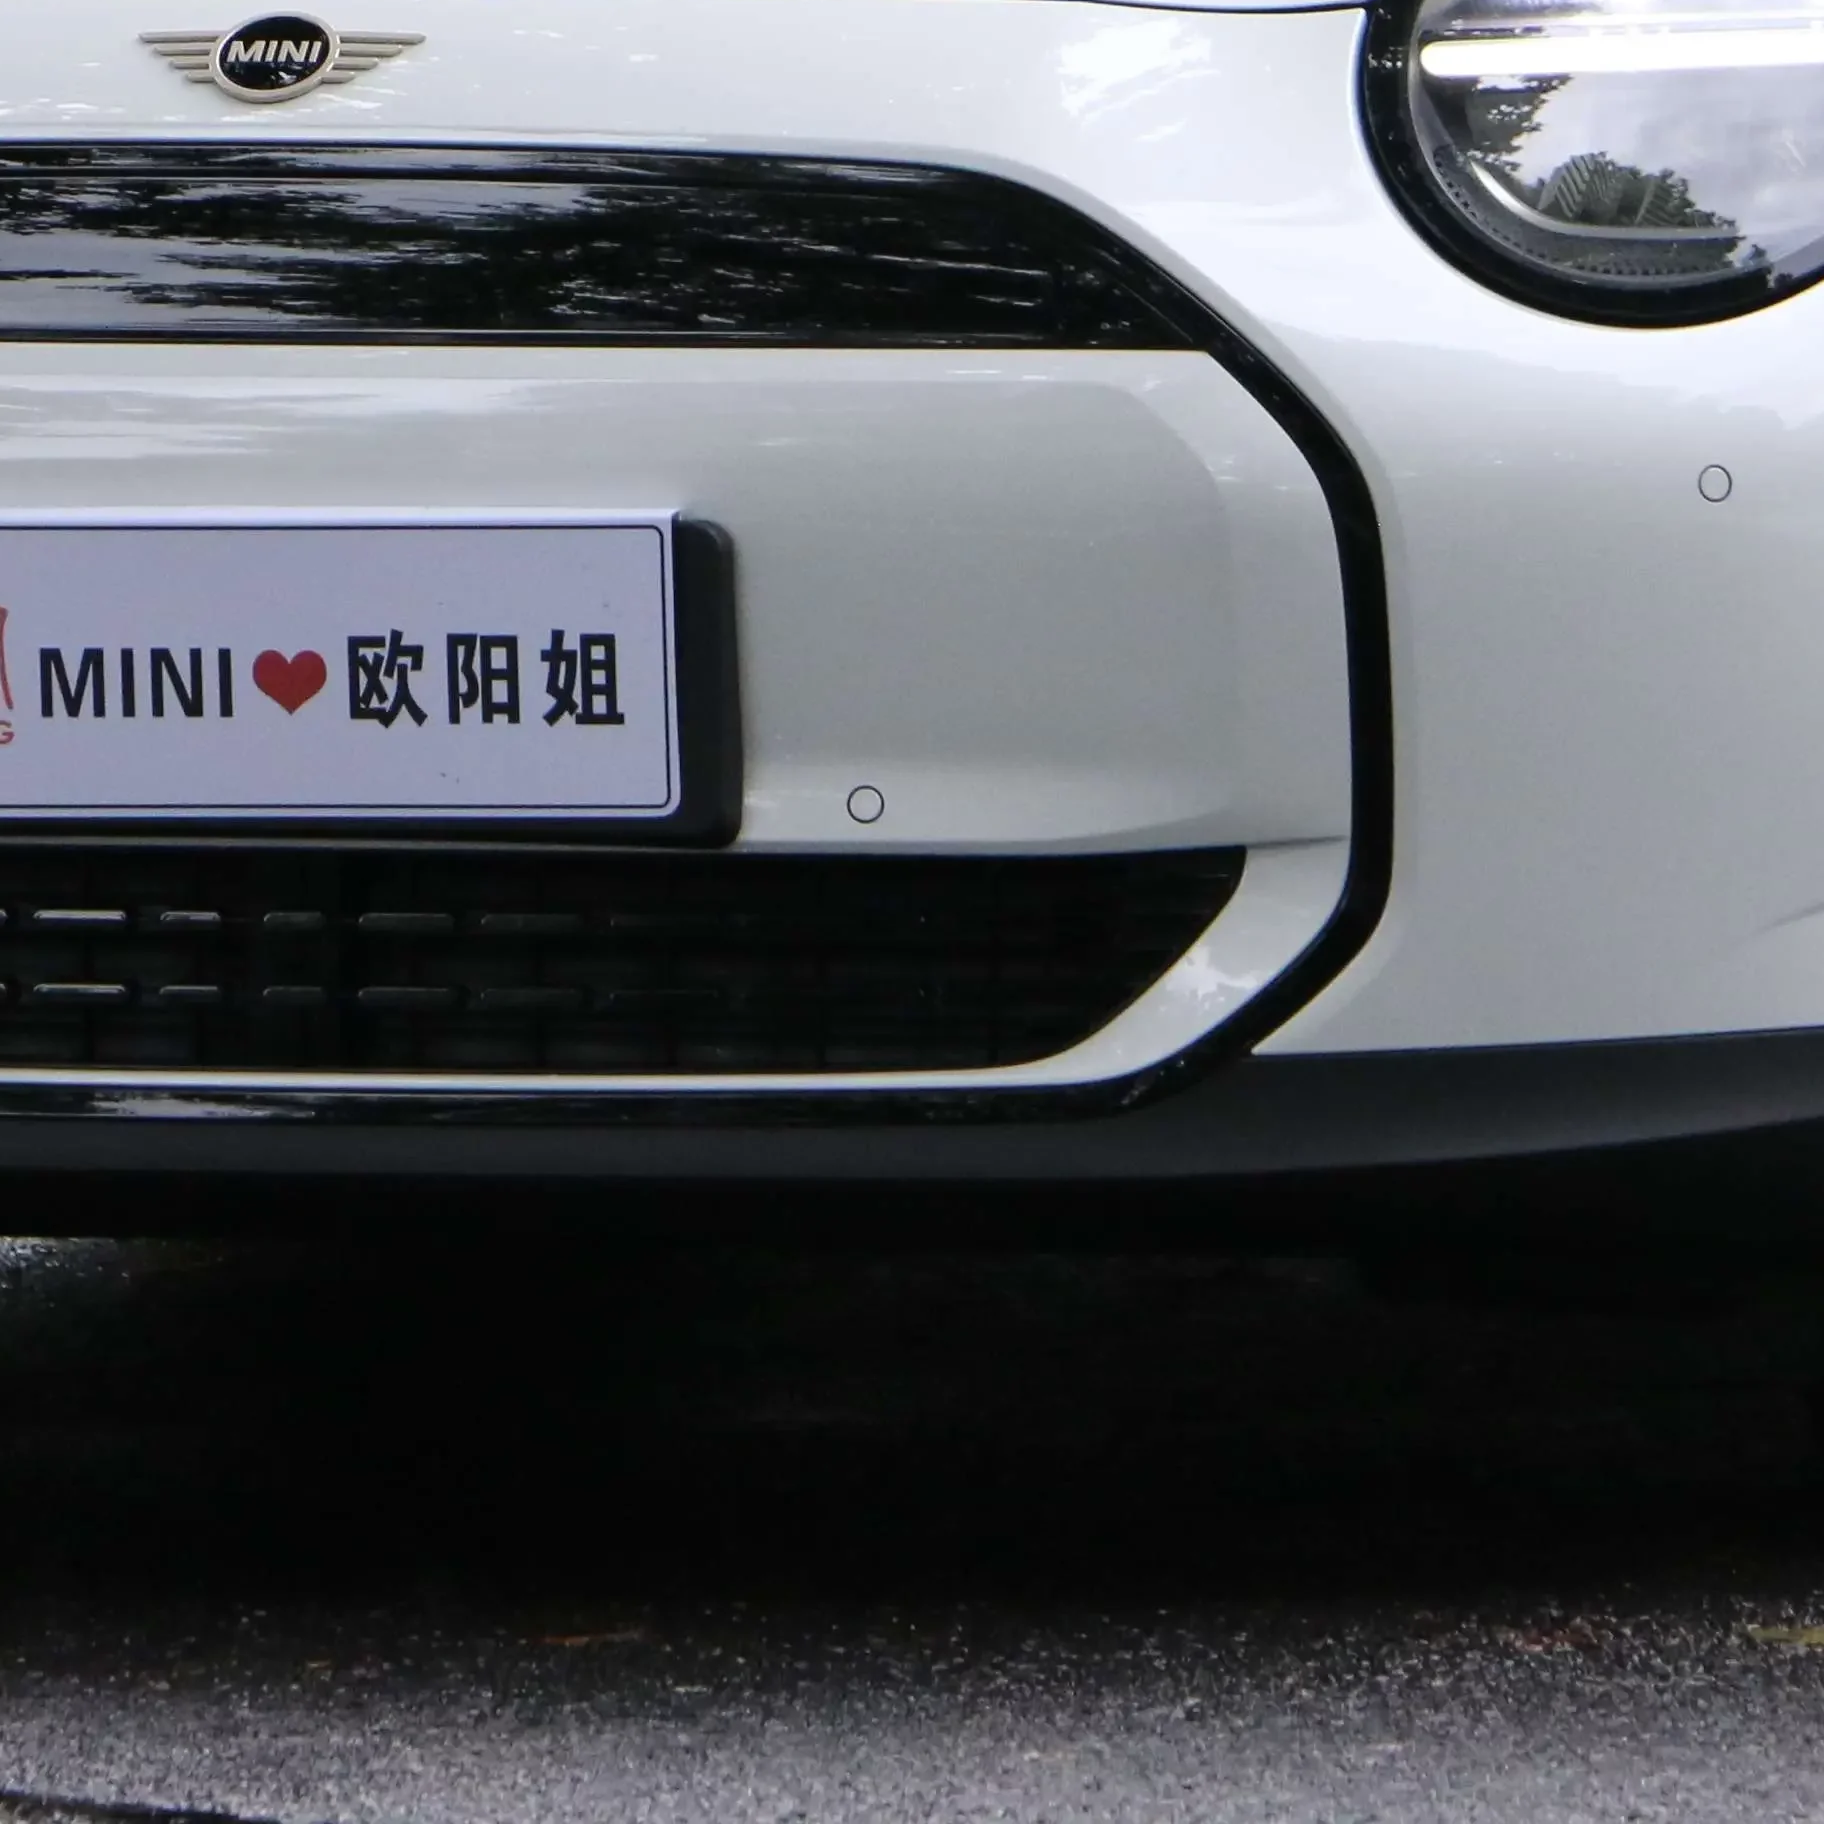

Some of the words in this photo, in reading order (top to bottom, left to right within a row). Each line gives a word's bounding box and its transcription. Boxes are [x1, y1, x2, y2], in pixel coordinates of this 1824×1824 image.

[226, 40, 323, 64] MINI
[38, 647, 234, 718] MINI
[347, 628, 625, 728] 欧阳姐
